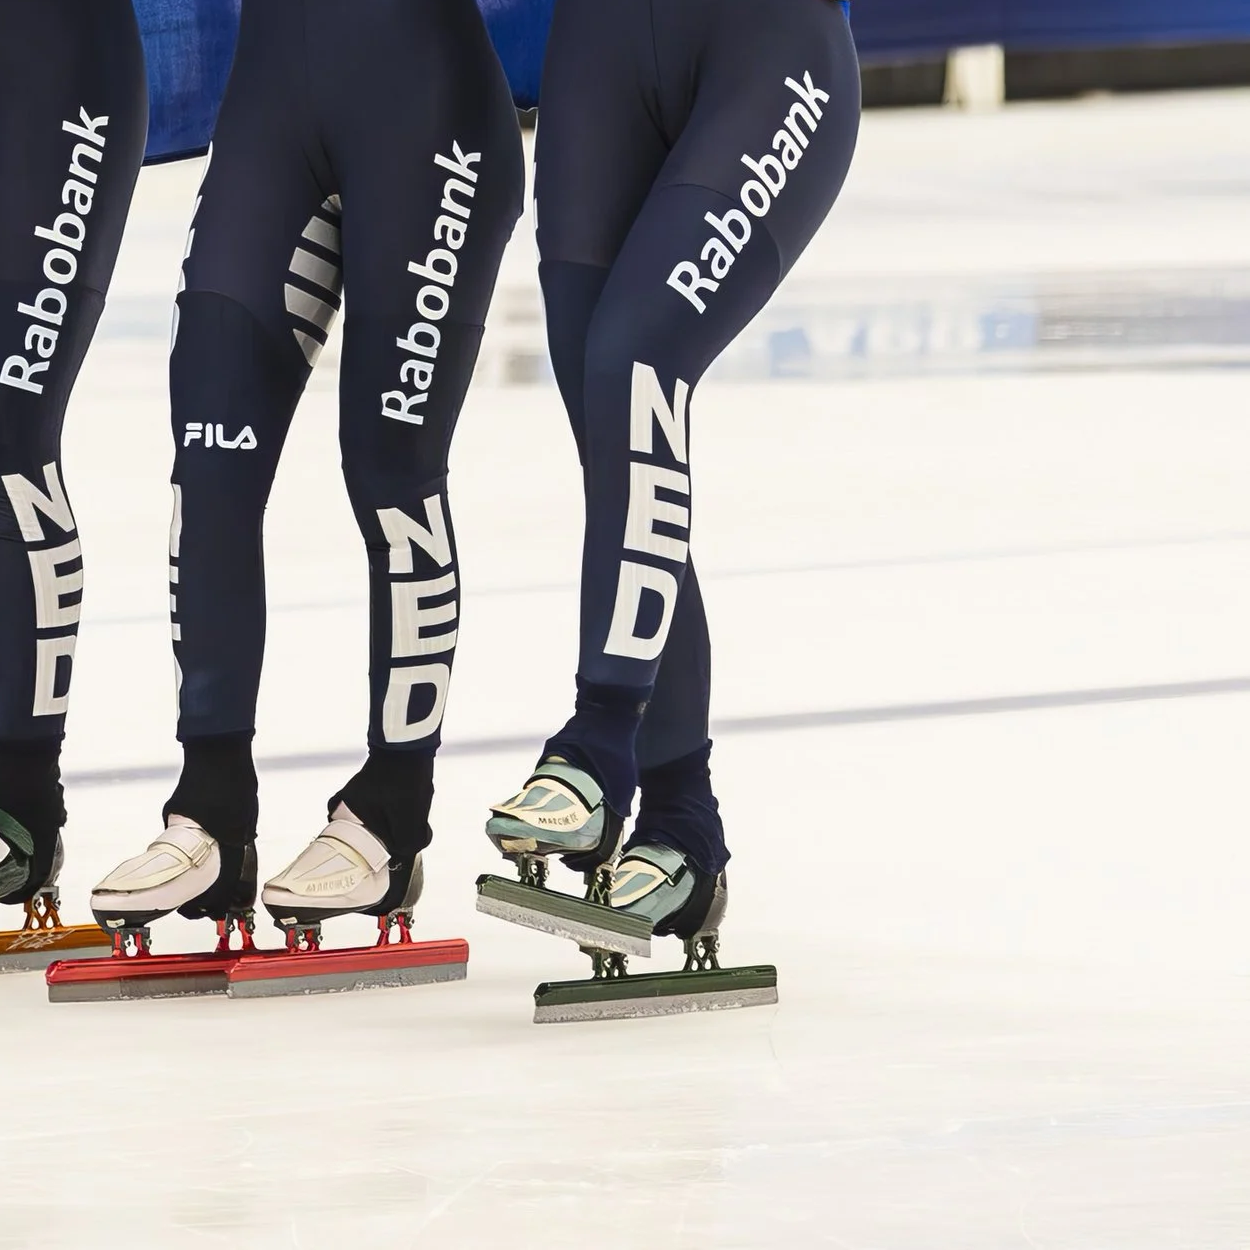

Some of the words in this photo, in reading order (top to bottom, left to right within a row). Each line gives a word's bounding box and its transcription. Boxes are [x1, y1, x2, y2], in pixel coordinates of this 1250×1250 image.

[380, 138, 482, 426] Rabobank
[666, 69, 831, 314] Rabobank
[183, 422, 258, 451] FILA
[602, 360, 692, 662] NED
[0, 461, 84, 717] NED
[375, 493, 459, 744] NED
